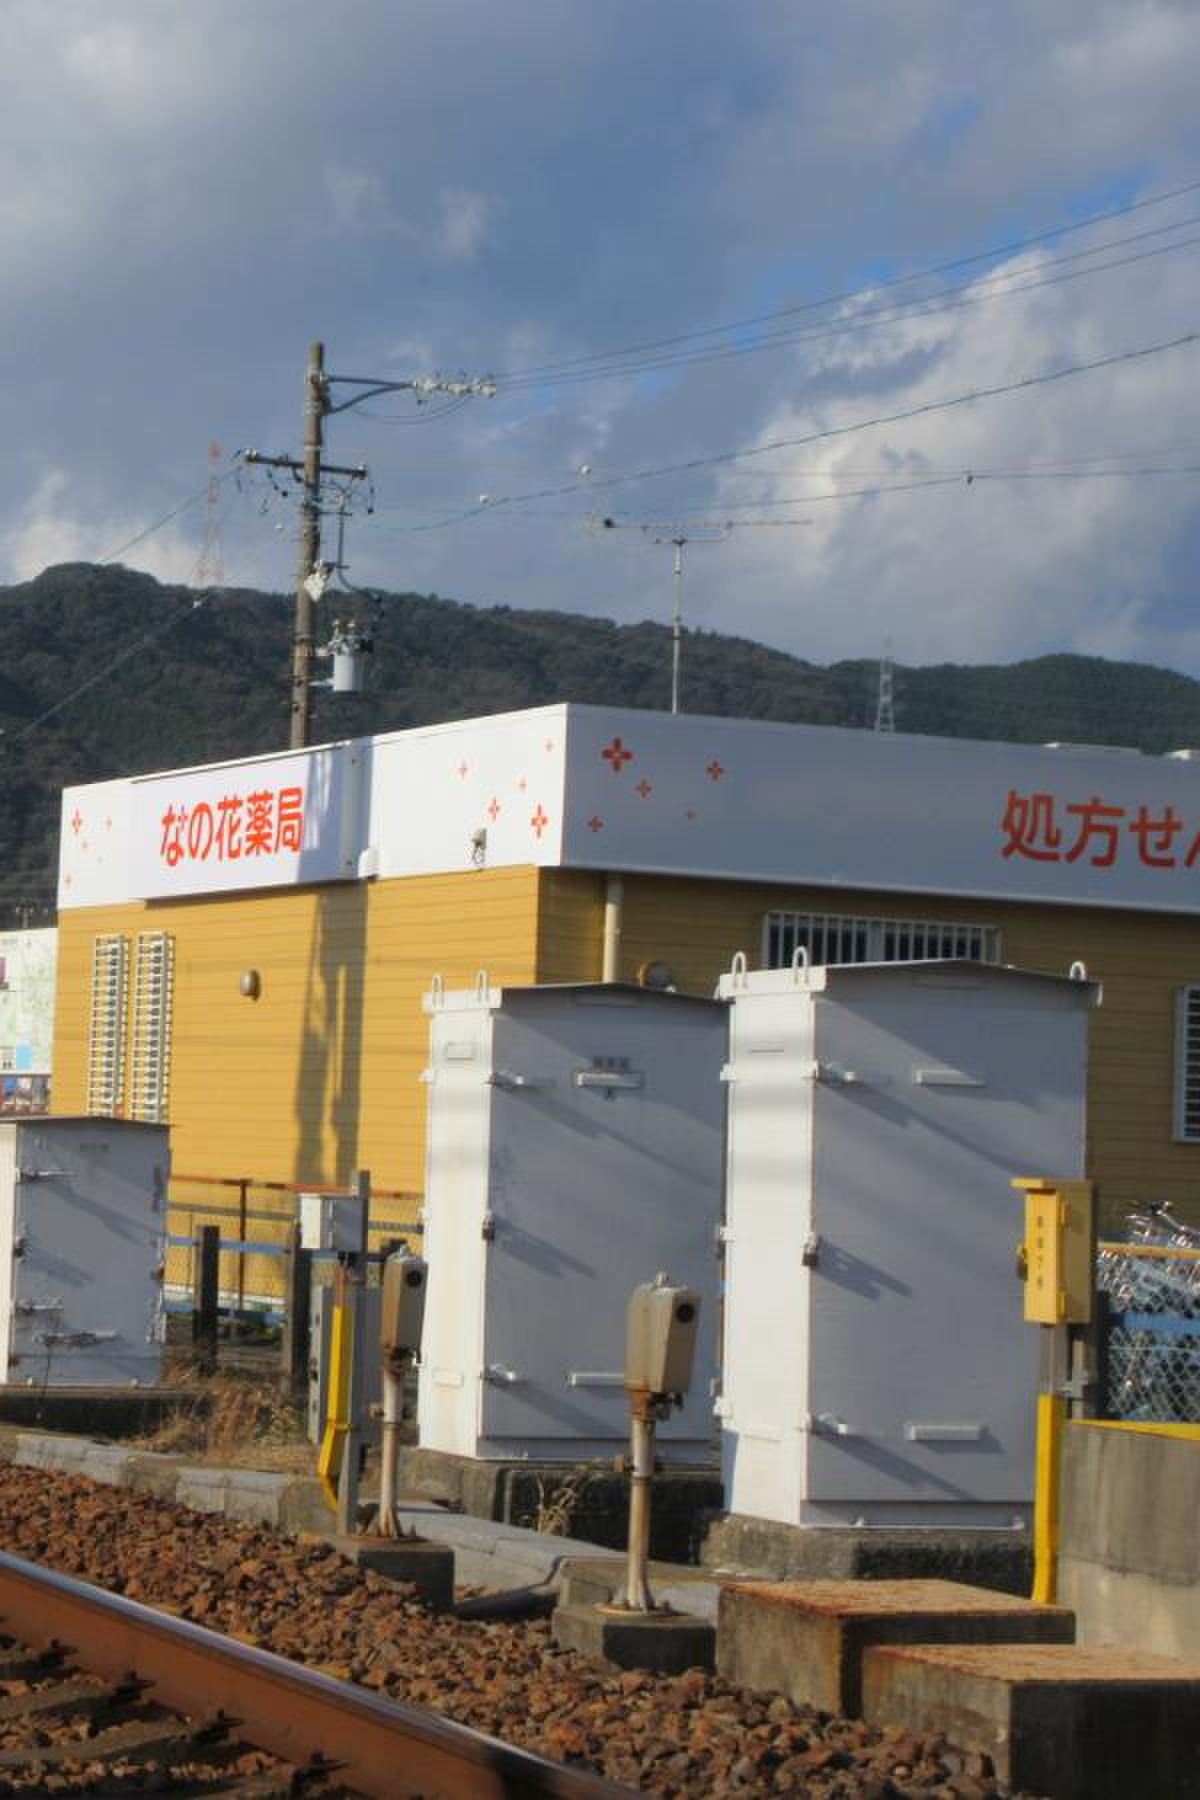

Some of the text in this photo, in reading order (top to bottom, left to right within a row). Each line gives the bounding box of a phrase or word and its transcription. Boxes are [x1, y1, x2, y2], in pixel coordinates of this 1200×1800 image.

[161, 786, 304, 866] なの花薬局
